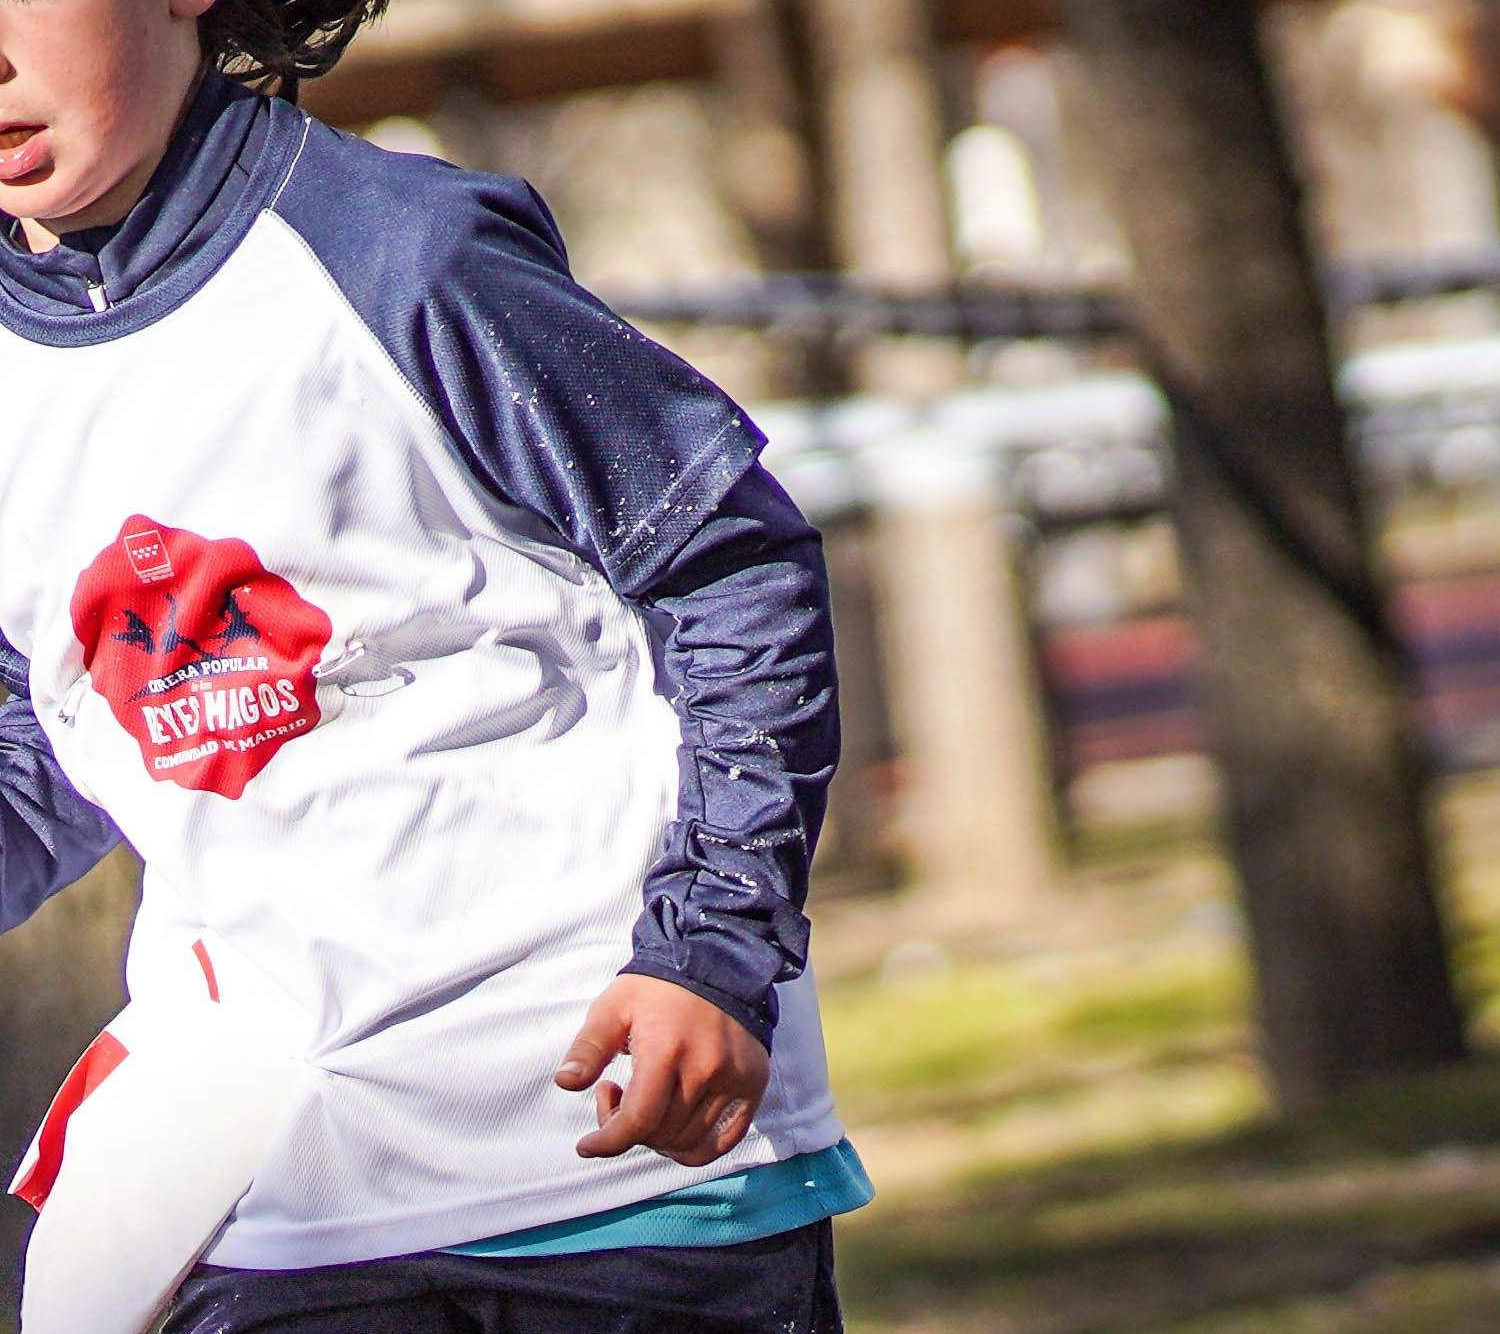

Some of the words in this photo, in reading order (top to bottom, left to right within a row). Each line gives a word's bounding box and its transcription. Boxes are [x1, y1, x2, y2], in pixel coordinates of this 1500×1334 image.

[201, 657, 268, 675] POPULAR
[204, 679, 299, 732] MAGOS
[237, 718, 307, 752] MADRID
